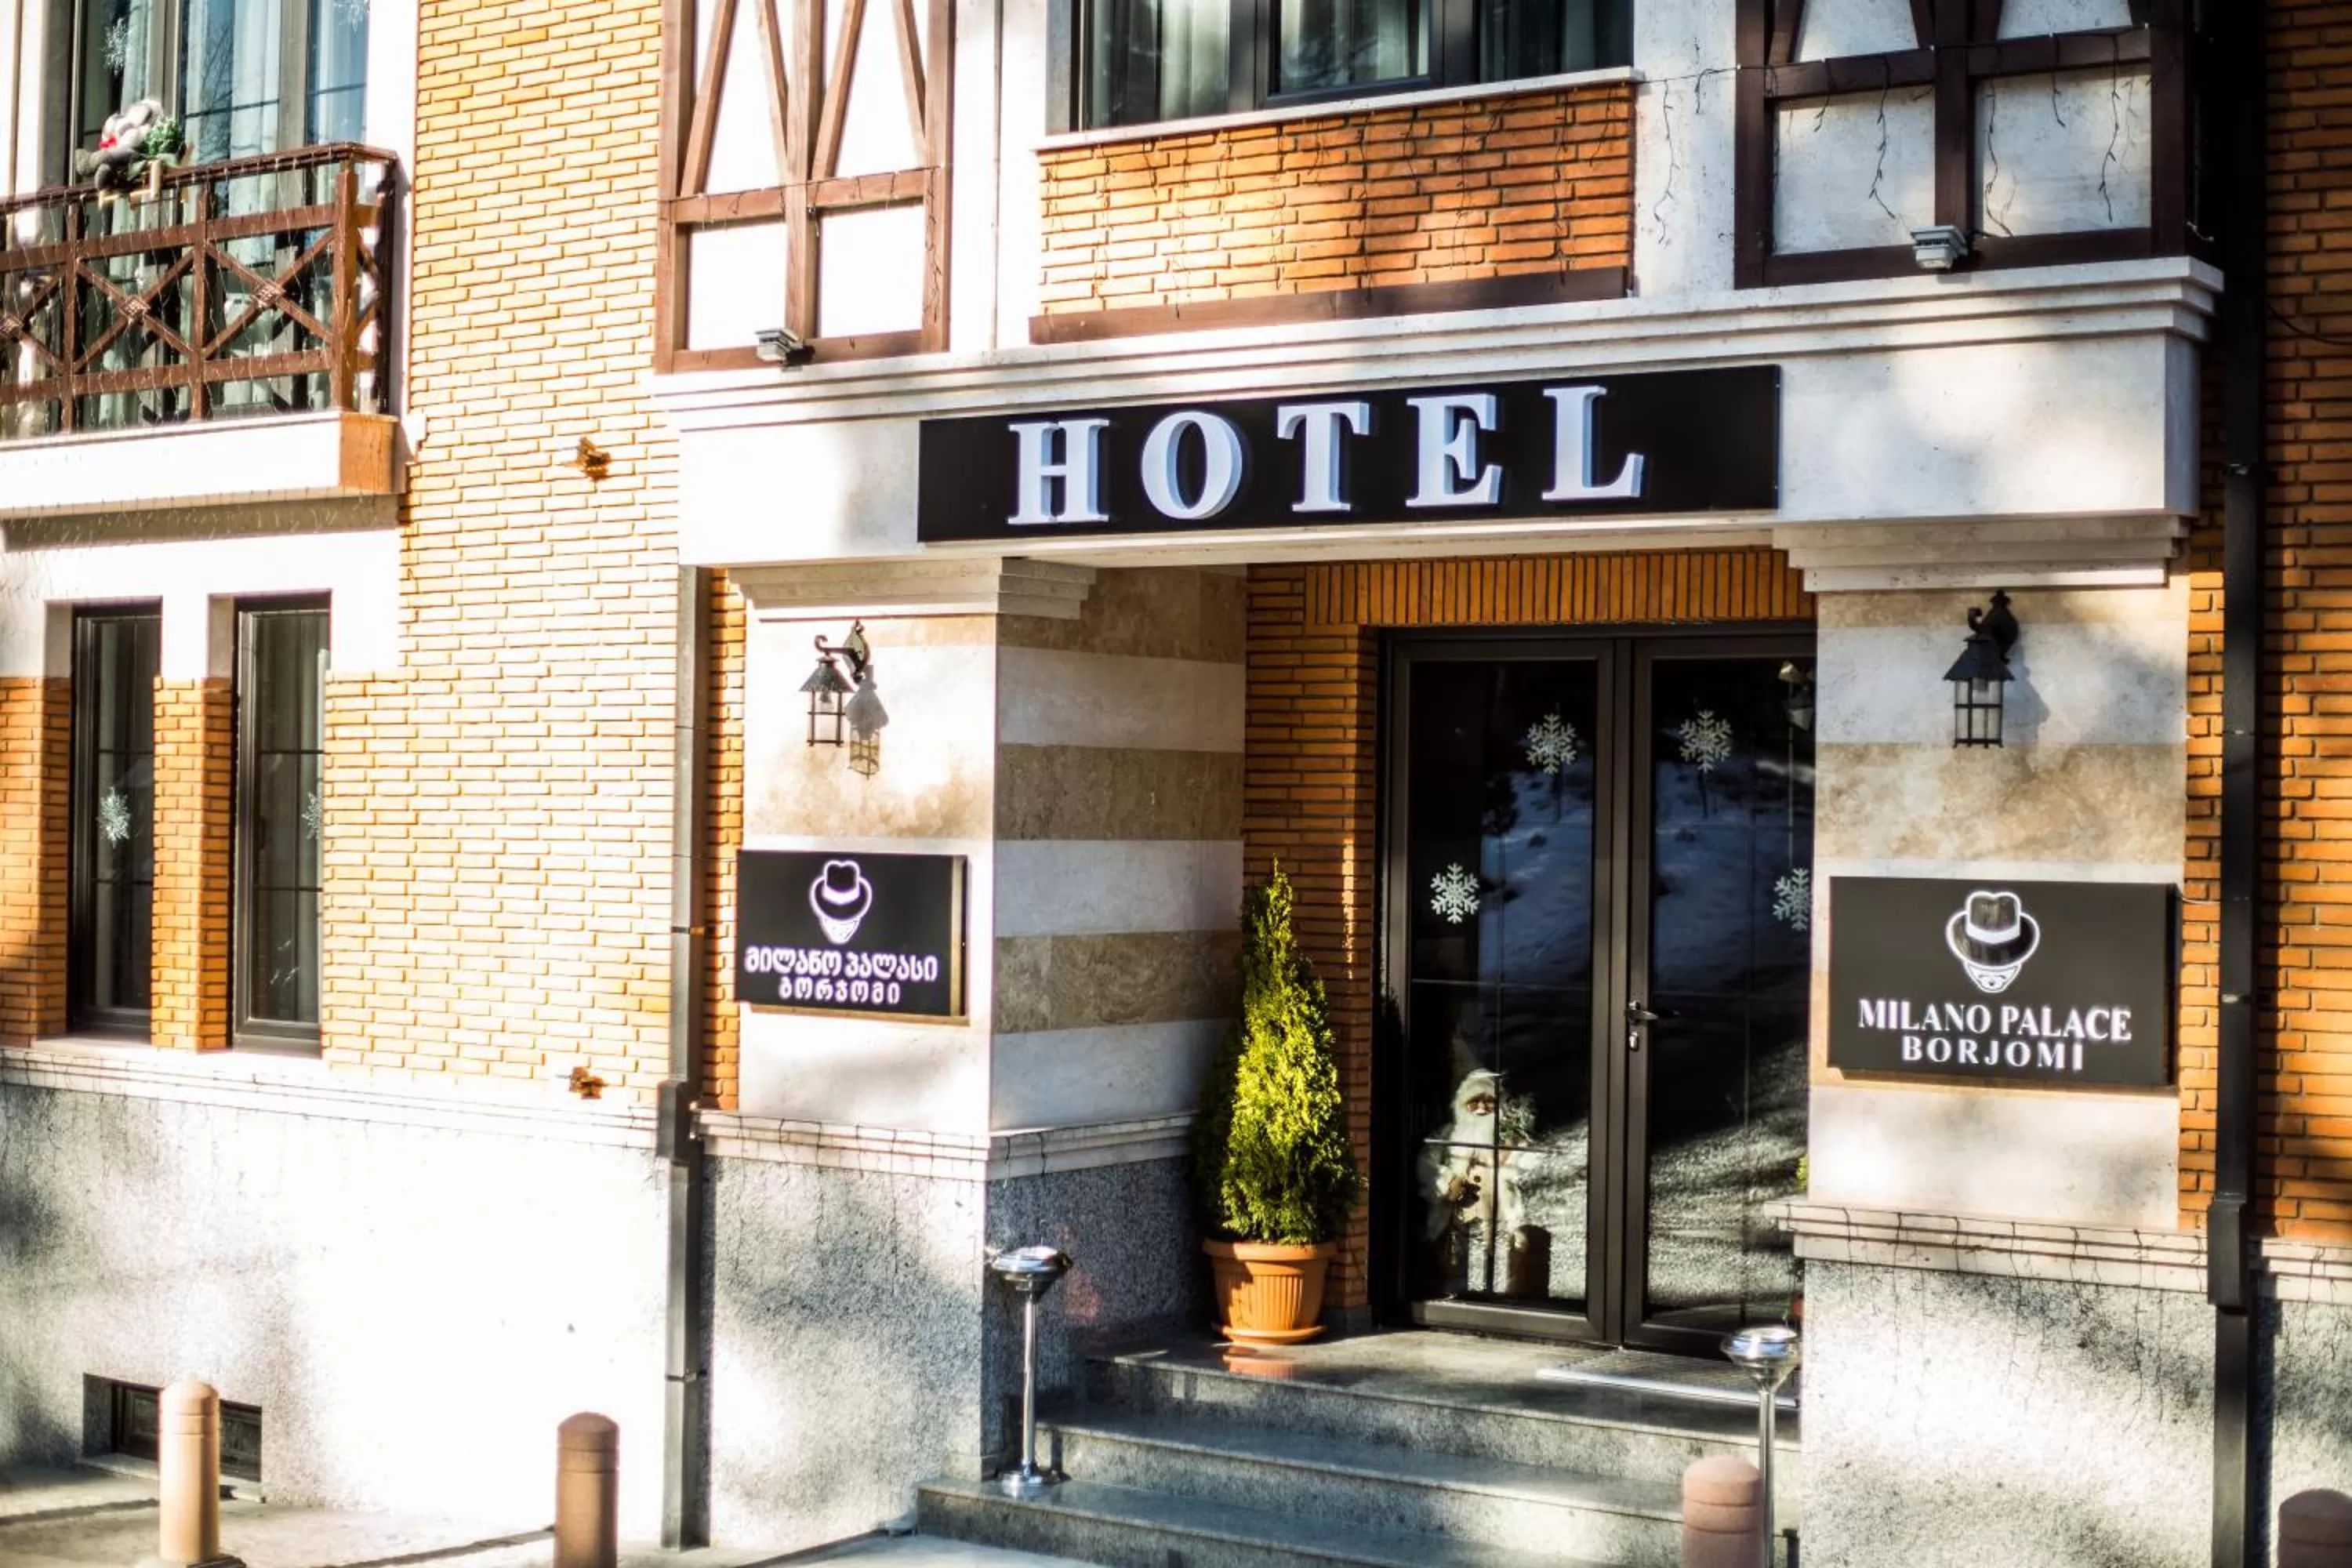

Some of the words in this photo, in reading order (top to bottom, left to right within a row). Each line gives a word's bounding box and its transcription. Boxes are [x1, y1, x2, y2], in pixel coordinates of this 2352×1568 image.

[1007, 385, 1645, 525] HOTEL
[744, 946, 843, 977] მილანო
[844, 951, 938, 982] პალასი
[779, 975, 901, 1004] ბორჯომი
[1858, 998, 1991, 1034] MILANO
[2000, 1005, 2132, 1043] PALACE
[1901, 1035, 2084, 1071] BORJOMI
